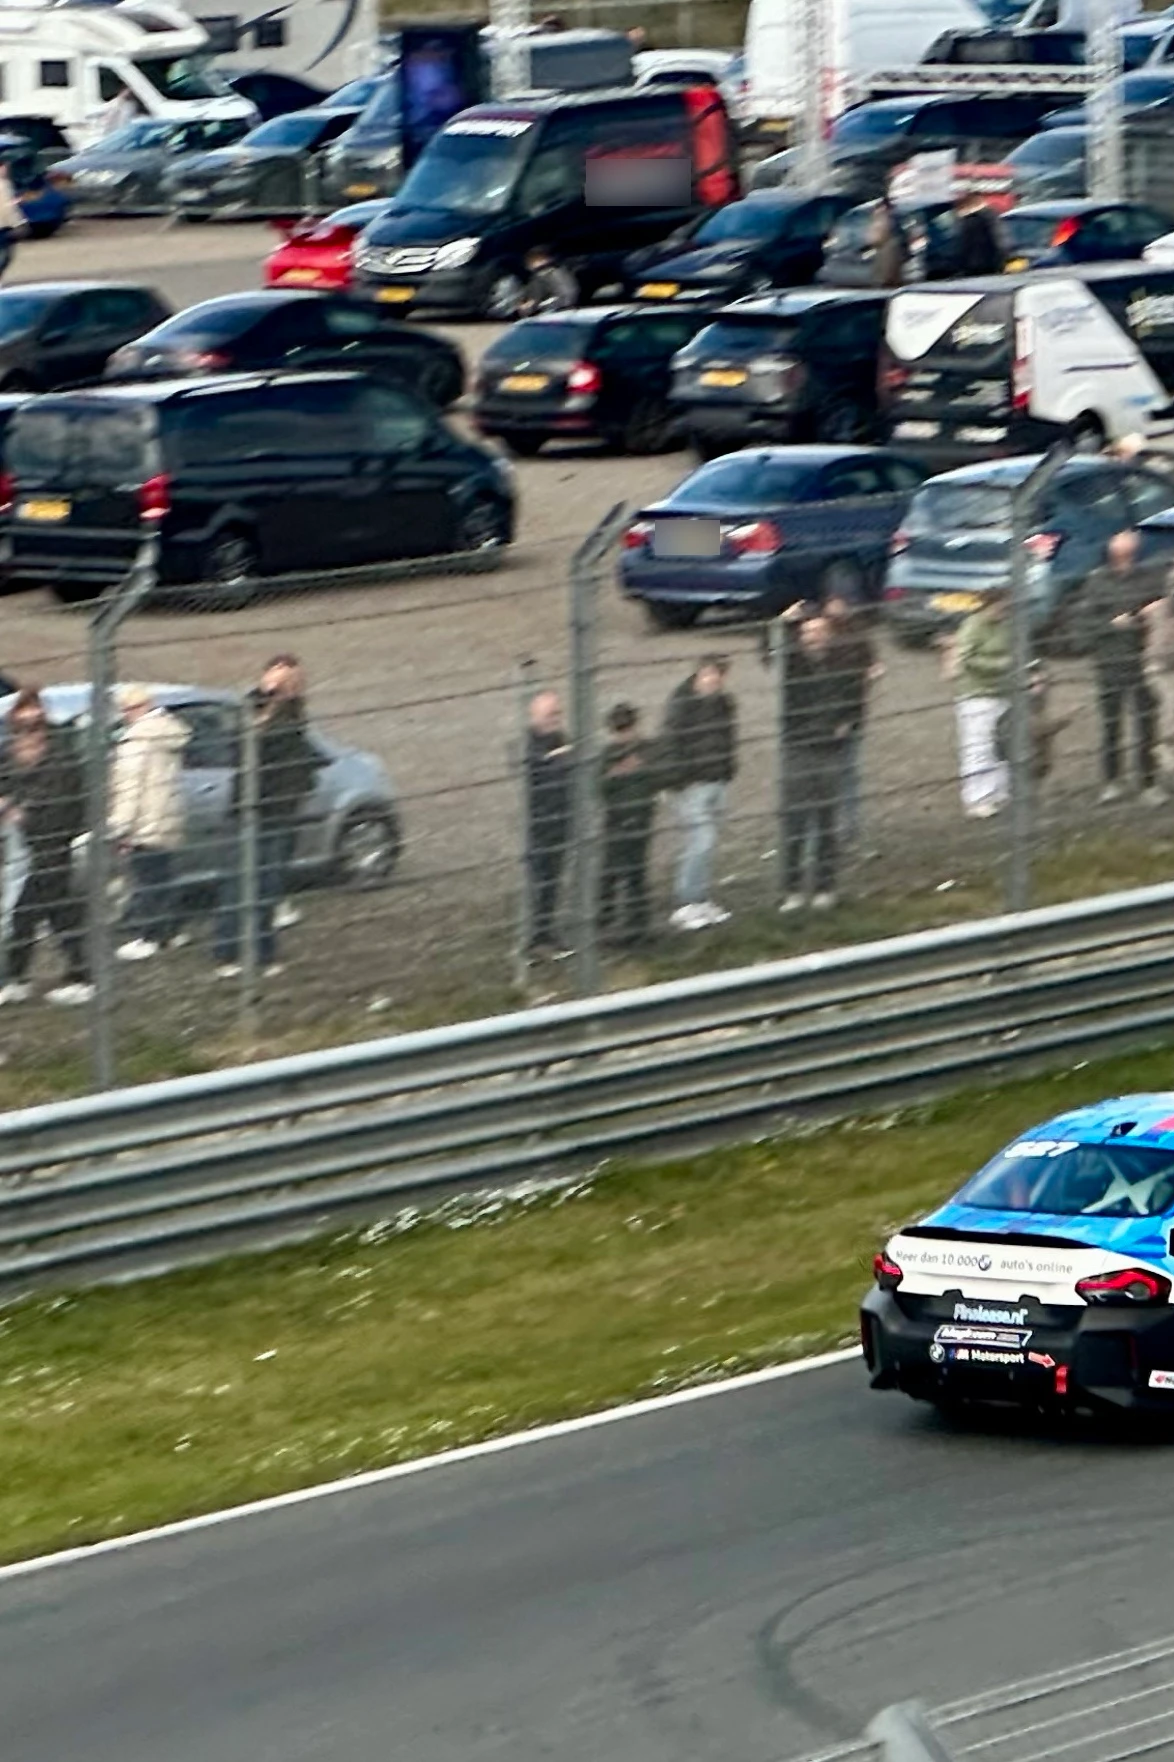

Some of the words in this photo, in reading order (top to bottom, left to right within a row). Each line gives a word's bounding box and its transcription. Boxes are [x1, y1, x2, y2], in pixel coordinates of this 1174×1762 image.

[920, 1252, 938, 1264] dan
[941, 1253, 979, 1267] 10000
[1001, 1258, 1034, 1272] auto's
[1036, 1262, 1073, 1274] online
[971, 1349, 1025, 1364] Motorsport
